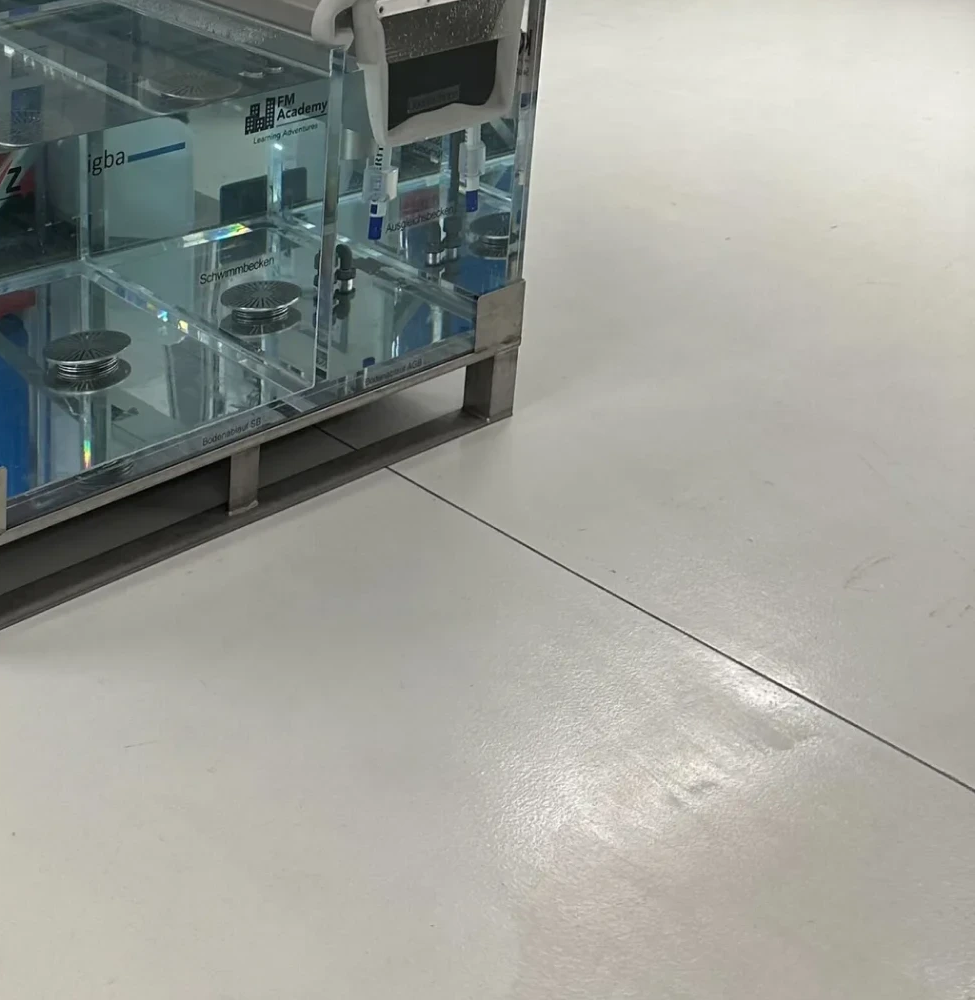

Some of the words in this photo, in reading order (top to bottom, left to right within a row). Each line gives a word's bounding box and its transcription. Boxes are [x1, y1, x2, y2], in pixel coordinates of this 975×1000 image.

[276, 100, 328, 121] Academy
[277, 93, 296, 108] FM
[253, 132, 282, 145] Learning
[281, 123, 319, 138] Adventures
[87, 149, 126, 176] igba
[199, 257, 275, 285] Schwimmbecken
